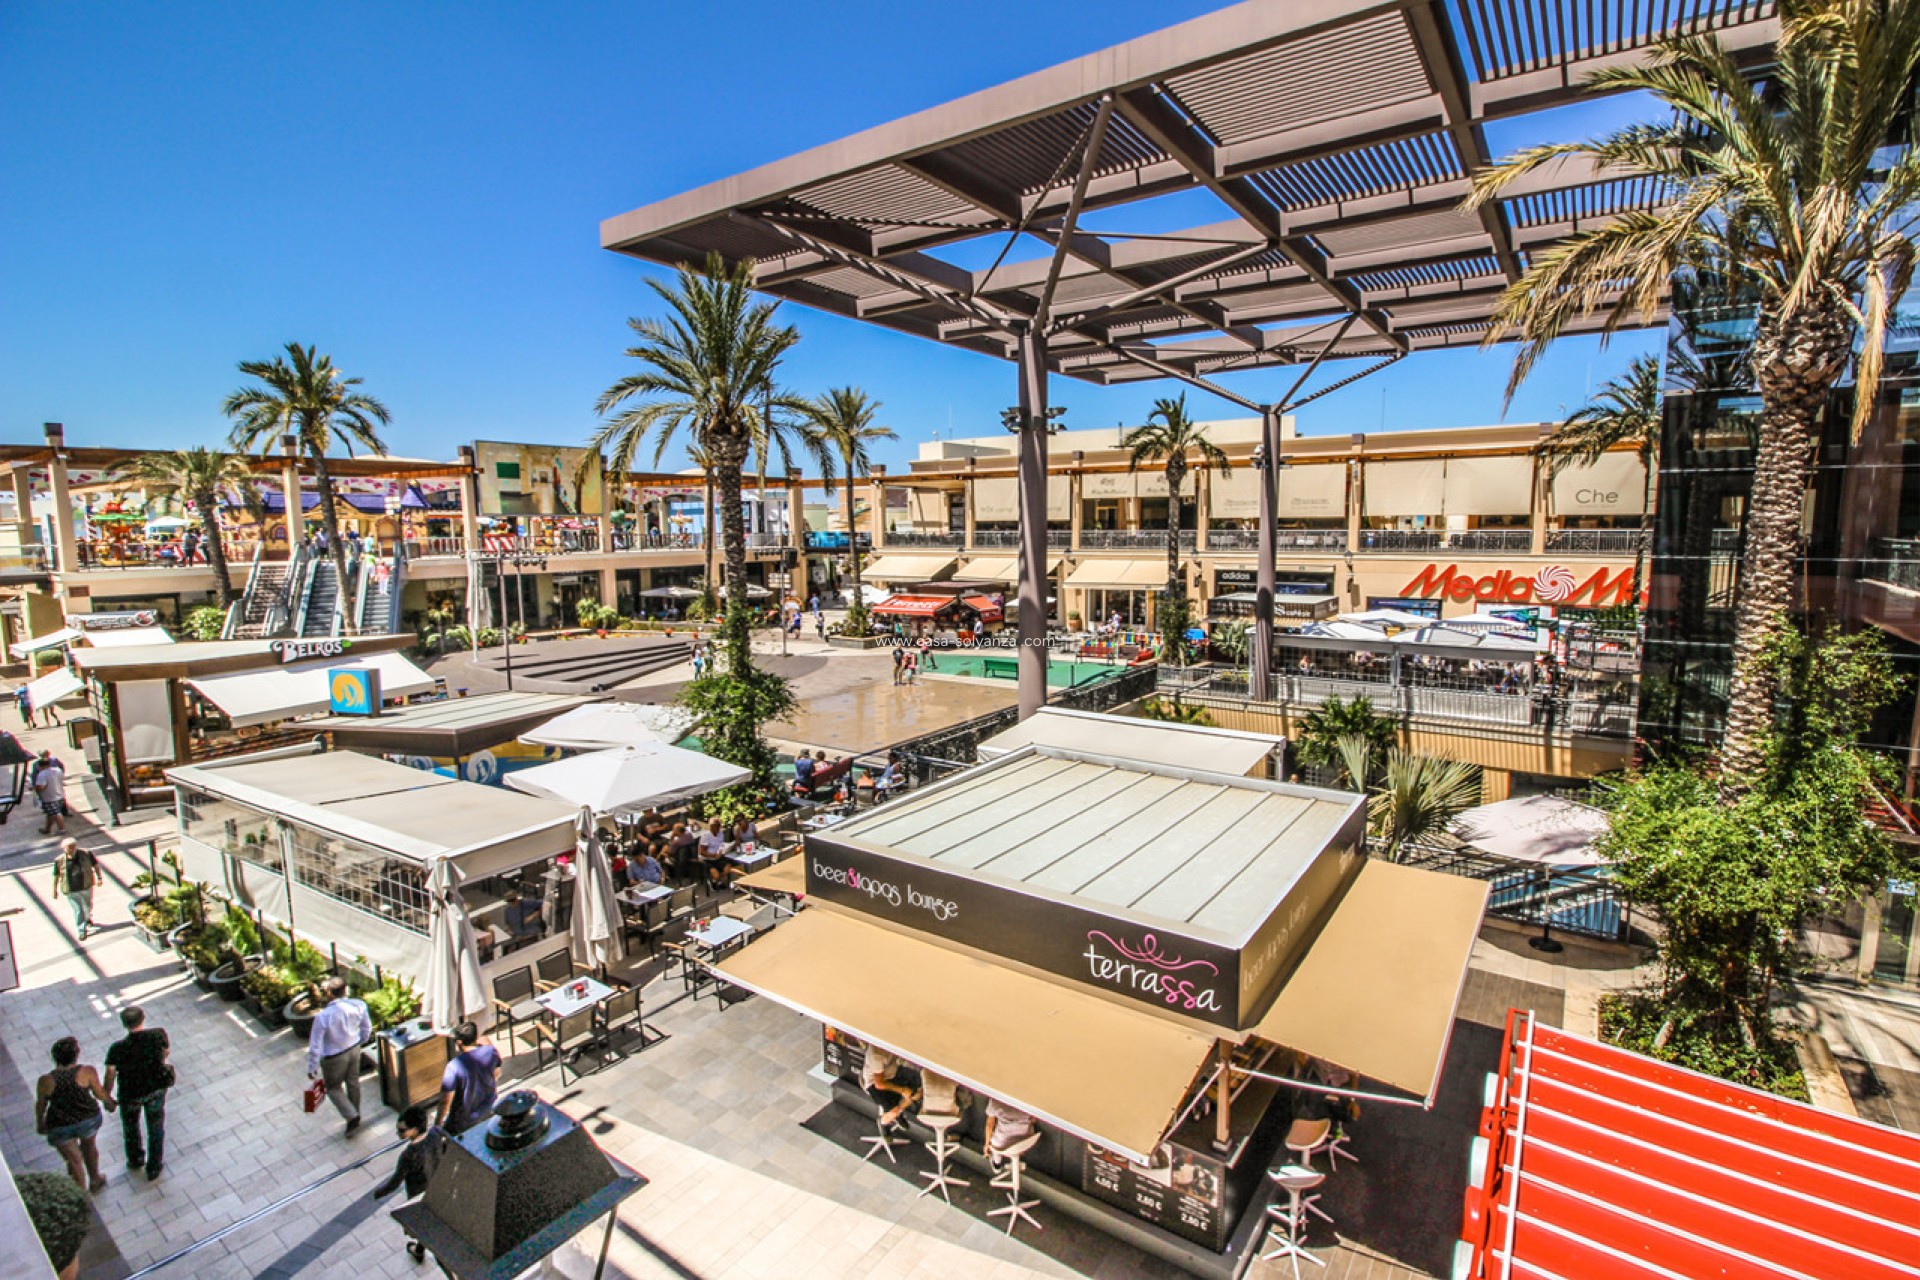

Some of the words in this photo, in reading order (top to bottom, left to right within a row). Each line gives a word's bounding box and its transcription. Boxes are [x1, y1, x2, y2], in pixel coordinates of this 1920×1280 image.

[1575, 488, 1619, 504] Che
[1221, 571, 1251, 581] adidas
[1398, 563, 1536, 602] Media
[907, 883, 959, 921] lounge
[1082, 943, 1223, 1013] terrassa
